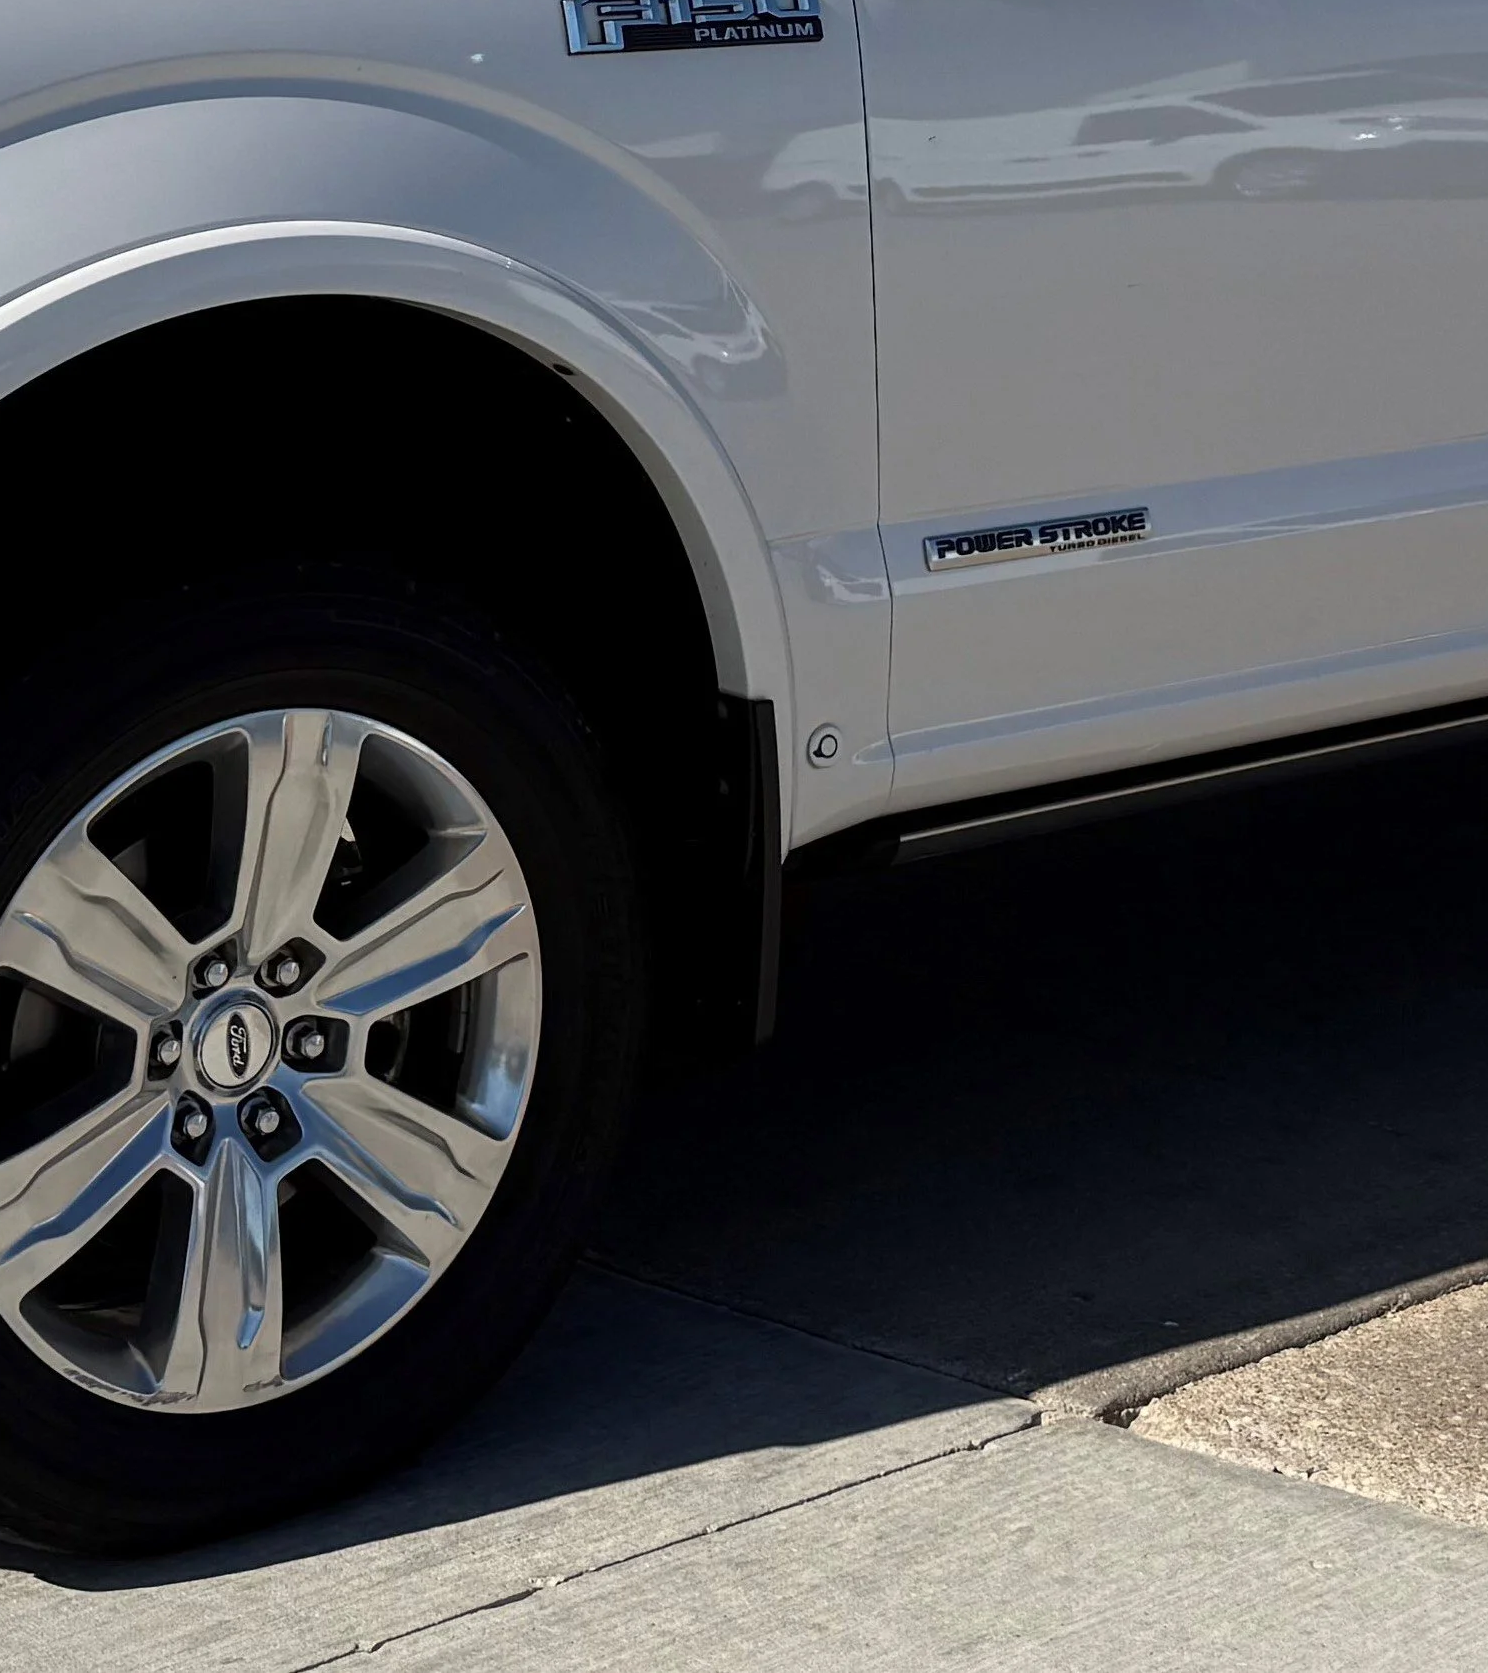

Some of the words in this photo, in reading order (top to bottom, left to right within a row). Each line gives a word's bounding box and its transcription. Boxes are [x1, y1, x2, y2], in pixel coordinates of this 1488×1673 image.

[694, 22, 814, 42] PLATINUM
[935, 528, 1034, 559] POWER
[1038, 512, 1146, 545] STROKE
[230, 1025, 247, 1067] Ford
